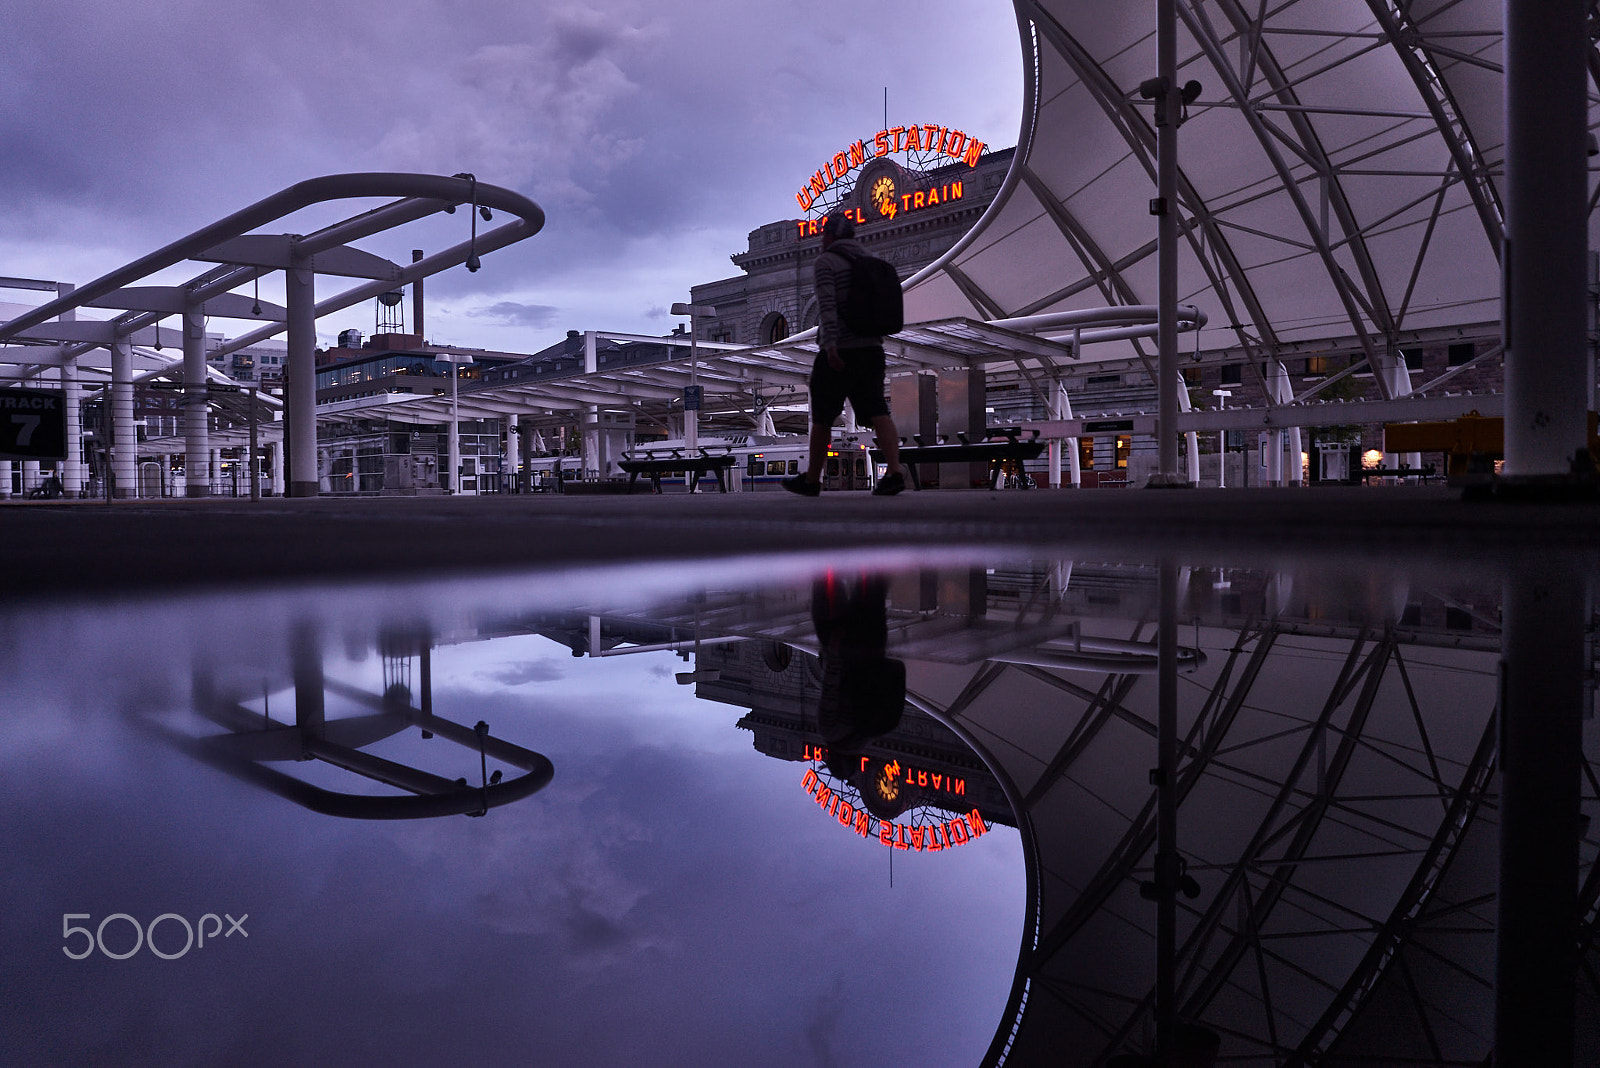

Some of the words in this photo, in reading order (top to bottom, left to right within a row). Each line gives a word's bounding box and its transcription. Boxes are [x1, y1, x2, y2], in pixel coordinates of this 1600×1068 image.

[796, 140, 865, 212] UNION
[874, 124, 985, 168] STATION
[797, 207, 866, 237] TRAEL
[879, 197, 898, 221] by
[901, 181, 964, 213] TRAIN
[0, 396, 57, 410] TRACK
[10, 413, 41, 446] 7
